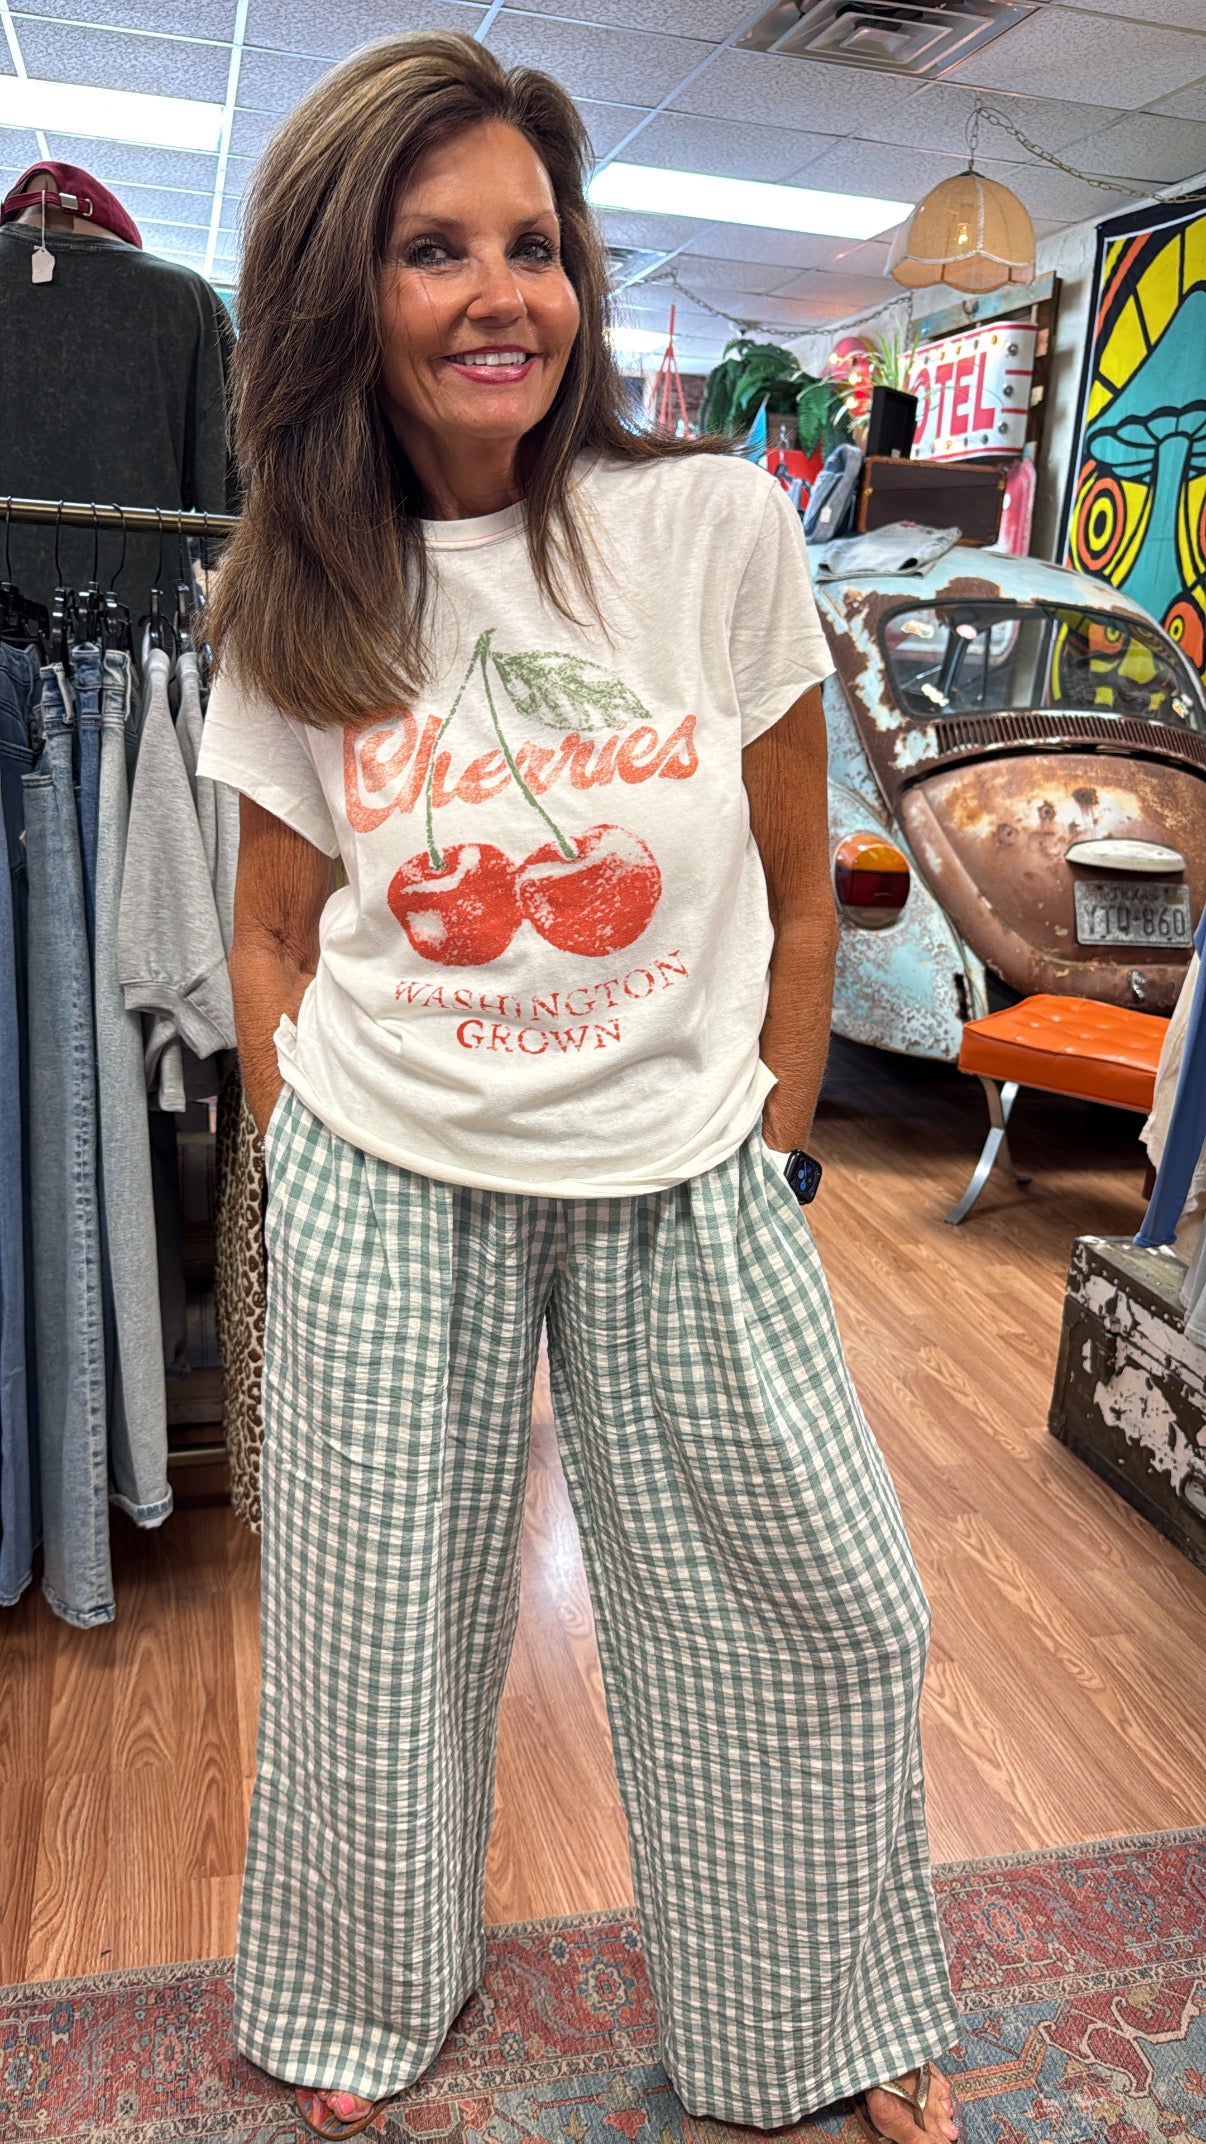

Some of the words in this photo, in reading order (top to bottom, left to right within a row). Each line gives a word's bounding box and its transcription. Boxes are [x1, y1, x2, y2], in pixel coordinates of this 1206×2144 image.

[904, 351, 996, 445] OTEL
[342, 704, 699, 833] Cherries
[395, 949, 689, 1021] WASHINGTON
[456, 1018, 621, 1055] GROWN
